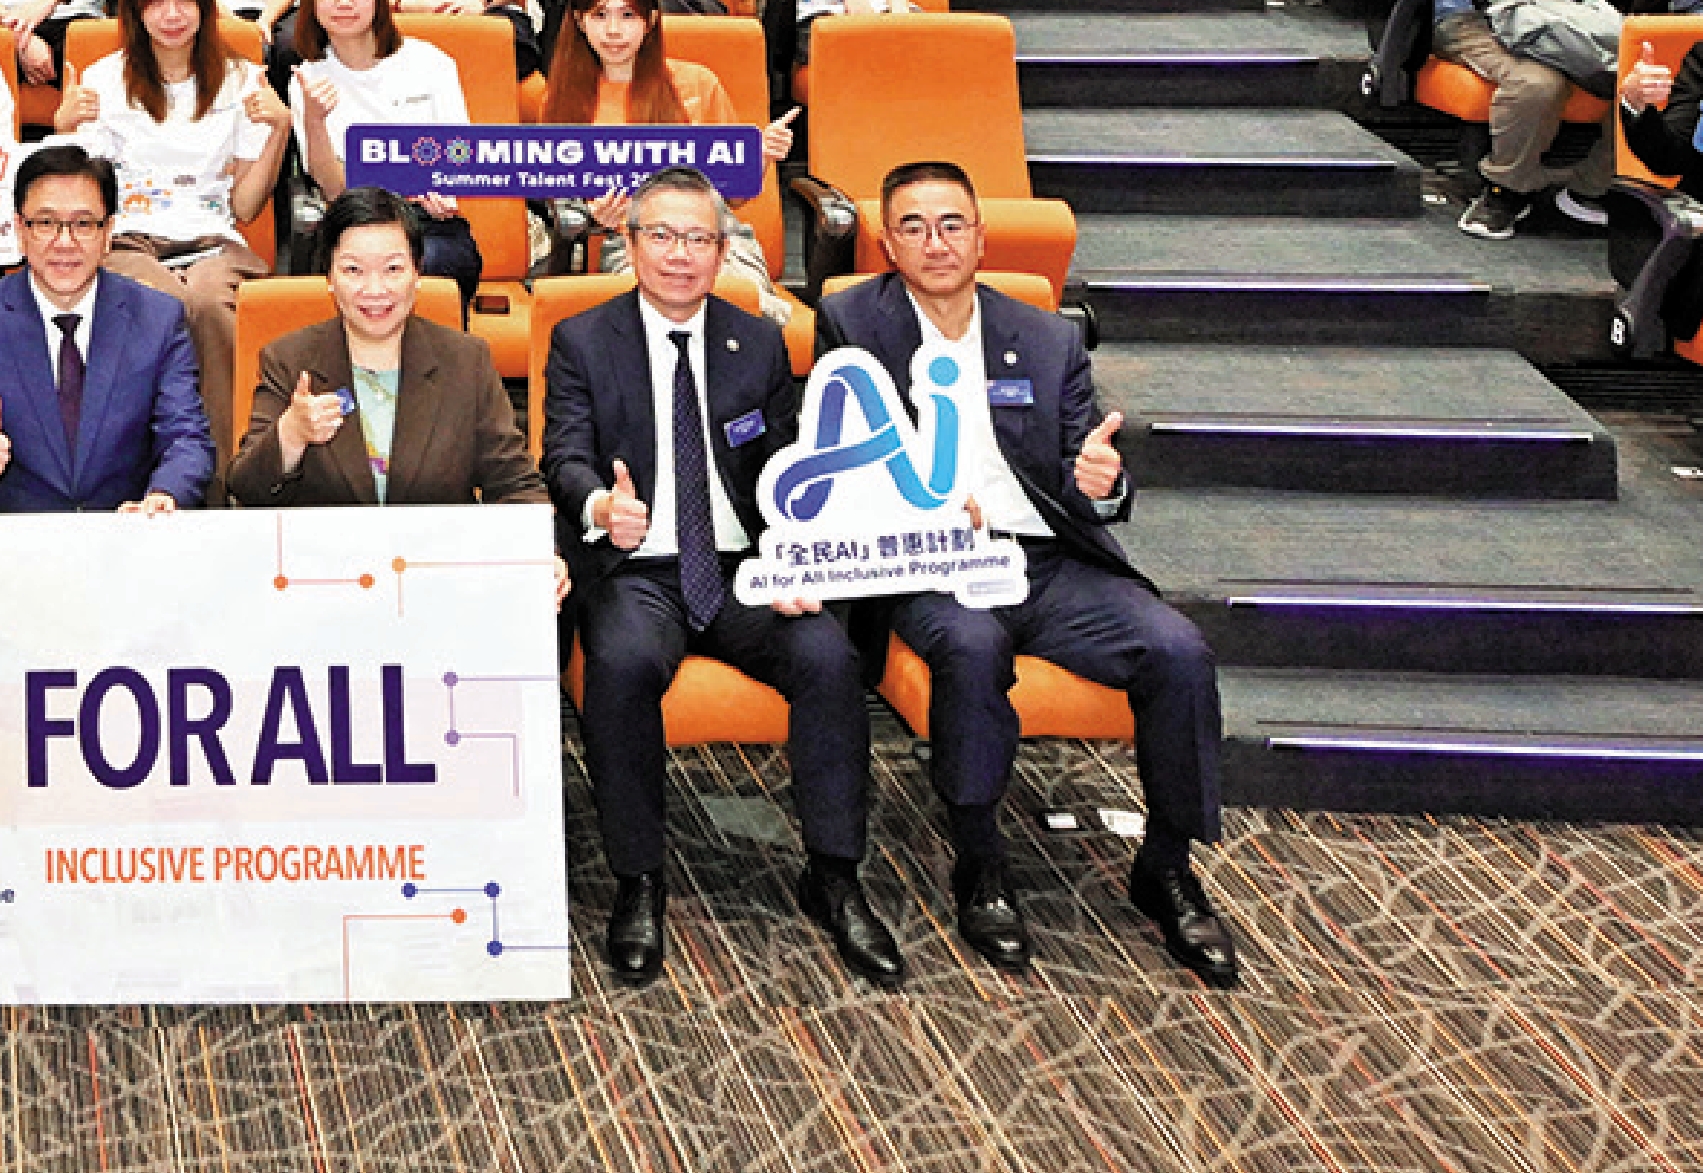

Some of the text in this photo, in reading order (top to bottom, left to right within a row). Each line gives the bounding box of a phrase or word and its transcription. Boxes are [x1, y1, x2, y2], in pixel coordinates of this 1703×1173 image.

[595, 139, 693, 164] WITH
[706, 139, 746, 164] AI
[431, 171, 511, 188] Summer
[518, 171, 576, 188] Talent
[25, 665, 234, 790] FOR
[250, 663, 438, 787] ALL
[45, 844, 427, 884] INCLUSIVE PROGRAMME
